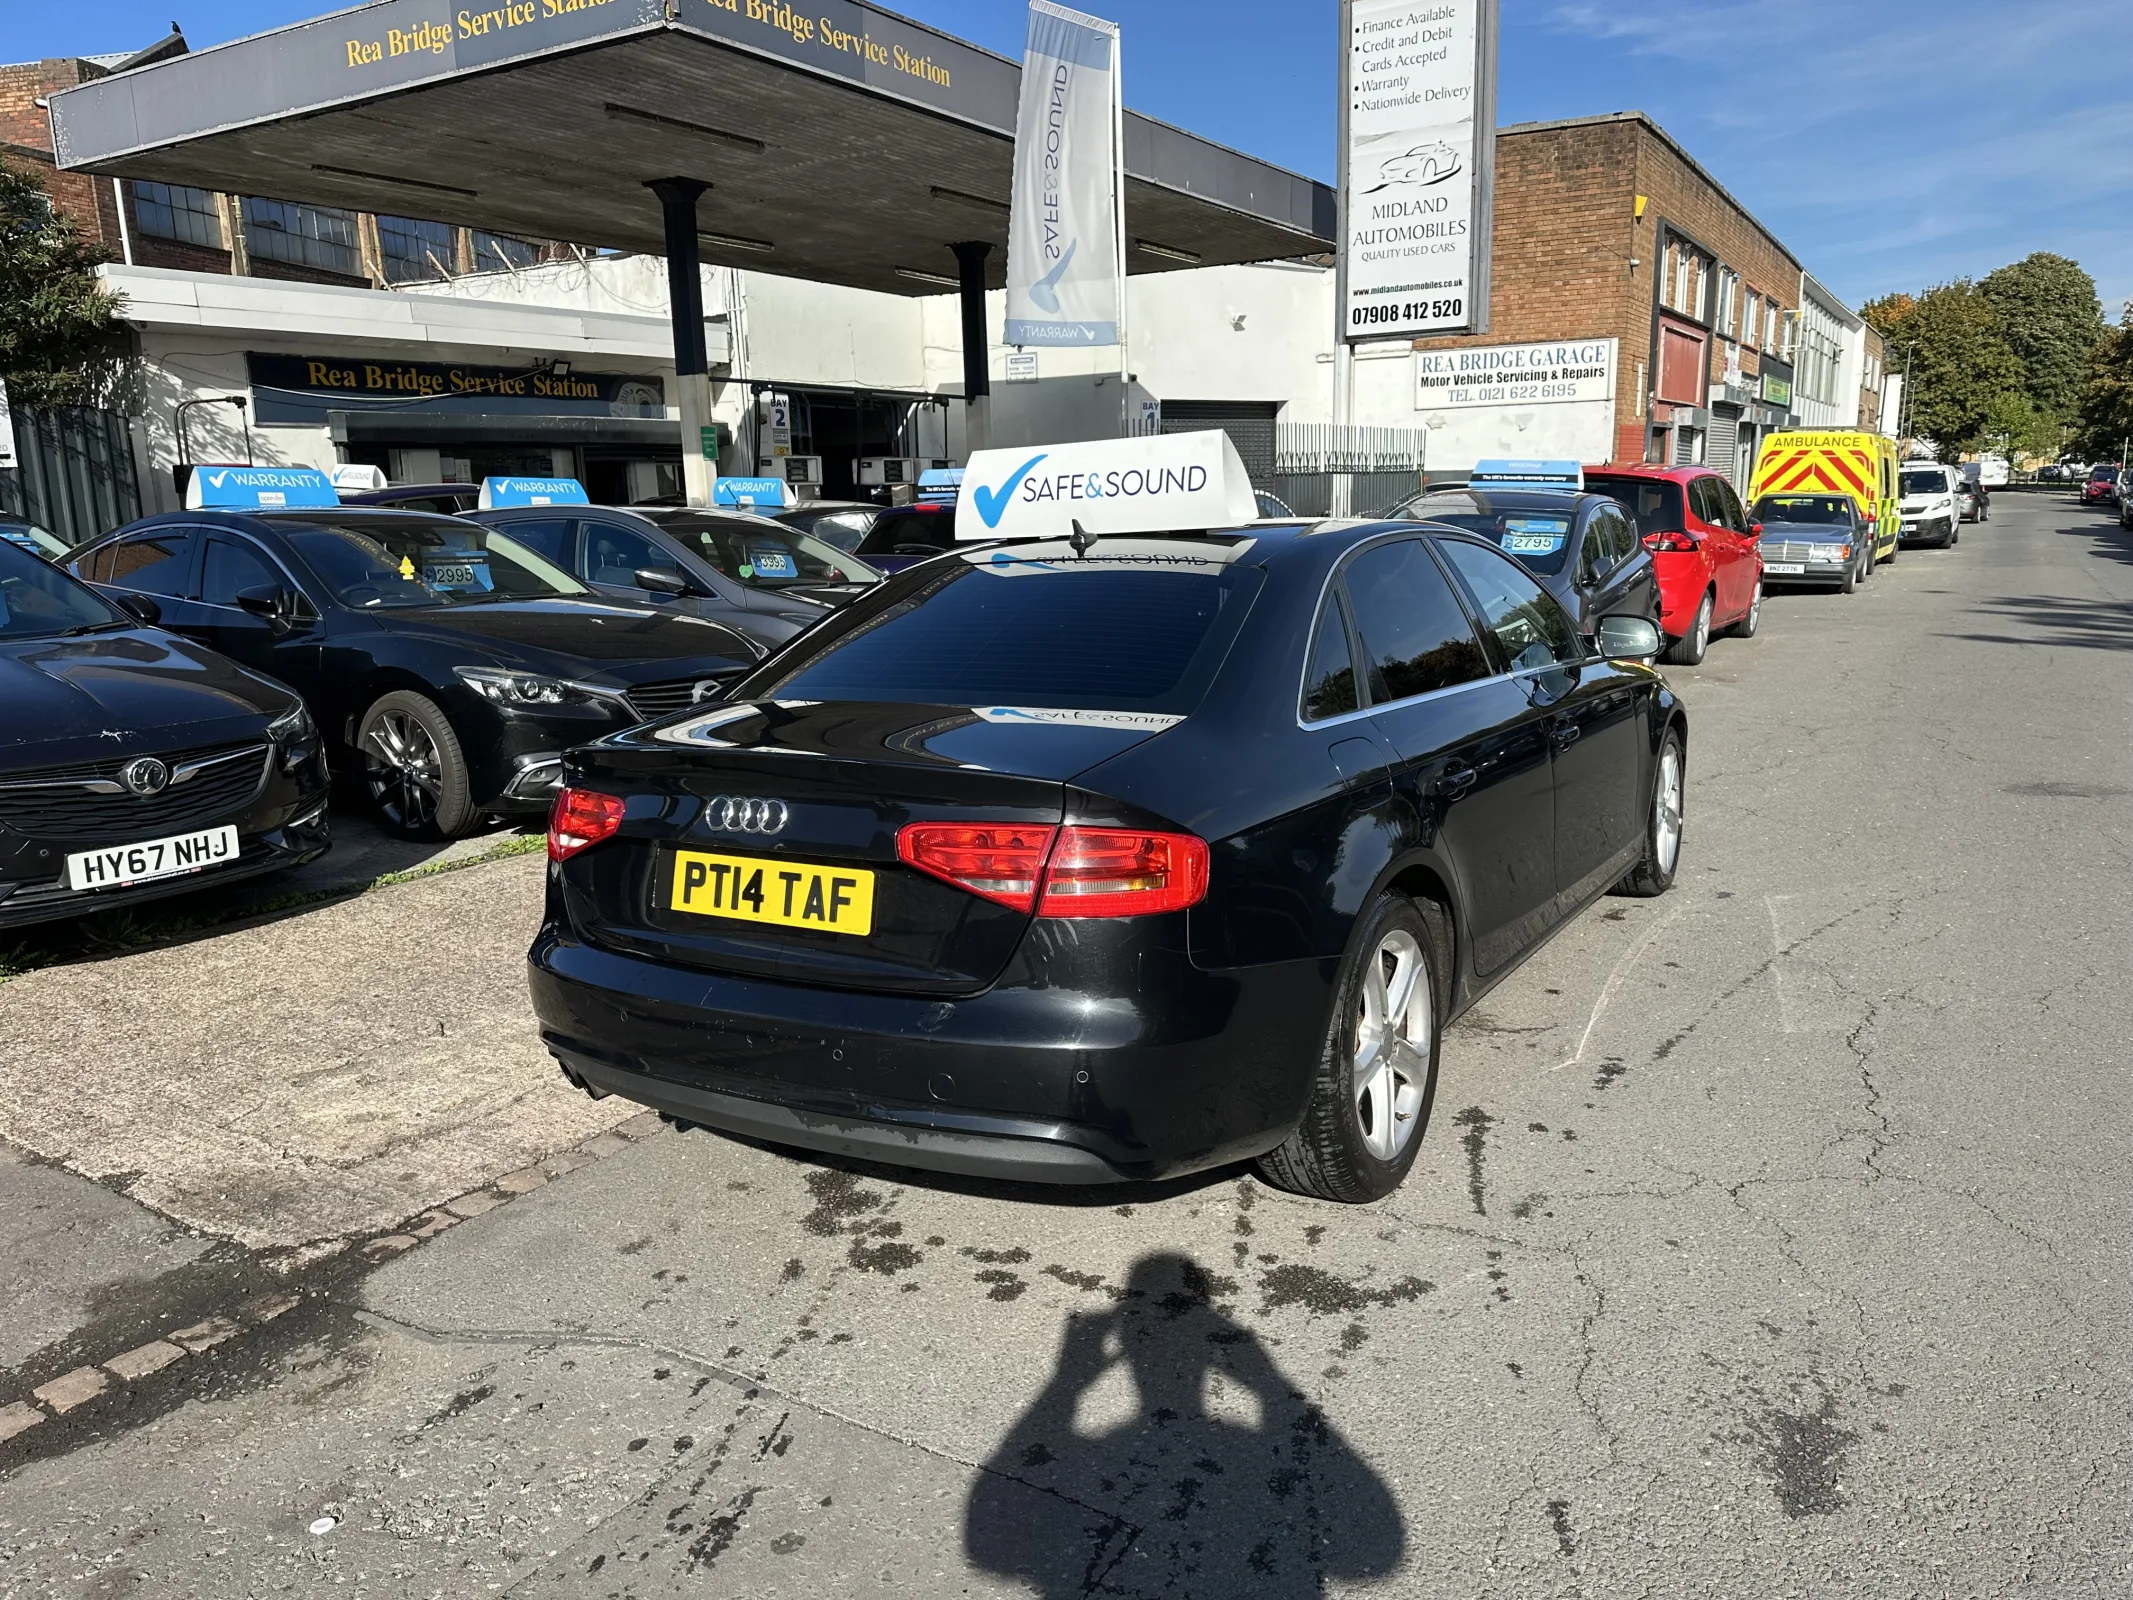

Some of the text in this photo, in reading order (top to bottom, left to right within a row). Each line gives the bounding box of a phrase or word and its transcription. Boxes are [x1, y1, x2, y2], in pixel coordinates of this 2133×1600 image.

[1362, 6, 1456, 34] Finance Available
[345, 40, 383, 67] Rea
[387, 21, 453, 54] Bridge
[457, 1, 536, 40] Service
[745, 0, 814, 43] Bridge
[820, 17, 888, 65] Service
[893, 44, 951, 88] Station
[1362, 27, 1452, 53] Credit and Debit
[1362, 46, 1447, 72] Cards Accepted
[1362, 76, 1410, 92] Warranty
[1361, 86, 1471, 112] Nationwide Delivery
[1372, 197, 1448, 220] MIDLAND
[1353, 220, 1466, 246] AUTOMOBILES
[1362, 242, 1456, 262] QUALITY USED CARS
[1353, 278, 1462, 296] www.midlandautomobiles.co.uk
[1352, 298, 1462, 325] 07908 412 520
[1422, 345, 1606, 374] REA BRIDGE GARAGE
[306, 361, 599, 398] Rea Bridge Service Station
[1420, 366, 1604, 388] Motor Vehicle Servicing & Repairs
[770, 399, 786, 408] BAY
[1448, 383, 1576, 402] TEL. 0121 622 6195
[775, 409, 786, 426] 2
[1142, 402, 1160, 410] BAY
[1774, 436, 1861, 447] AMBULANCE
[231, 472, 320, 488] WARRANTY
[511, 482, 576, 494] WARRANTY
[730, 482, 776, 492] WARRANTY
[1022, 466, 1207, 502] SAFE&SOUND
[84, 832, 228, 882] HY67 NHJ
[683, 861, 856, 923] PT14 TAF
